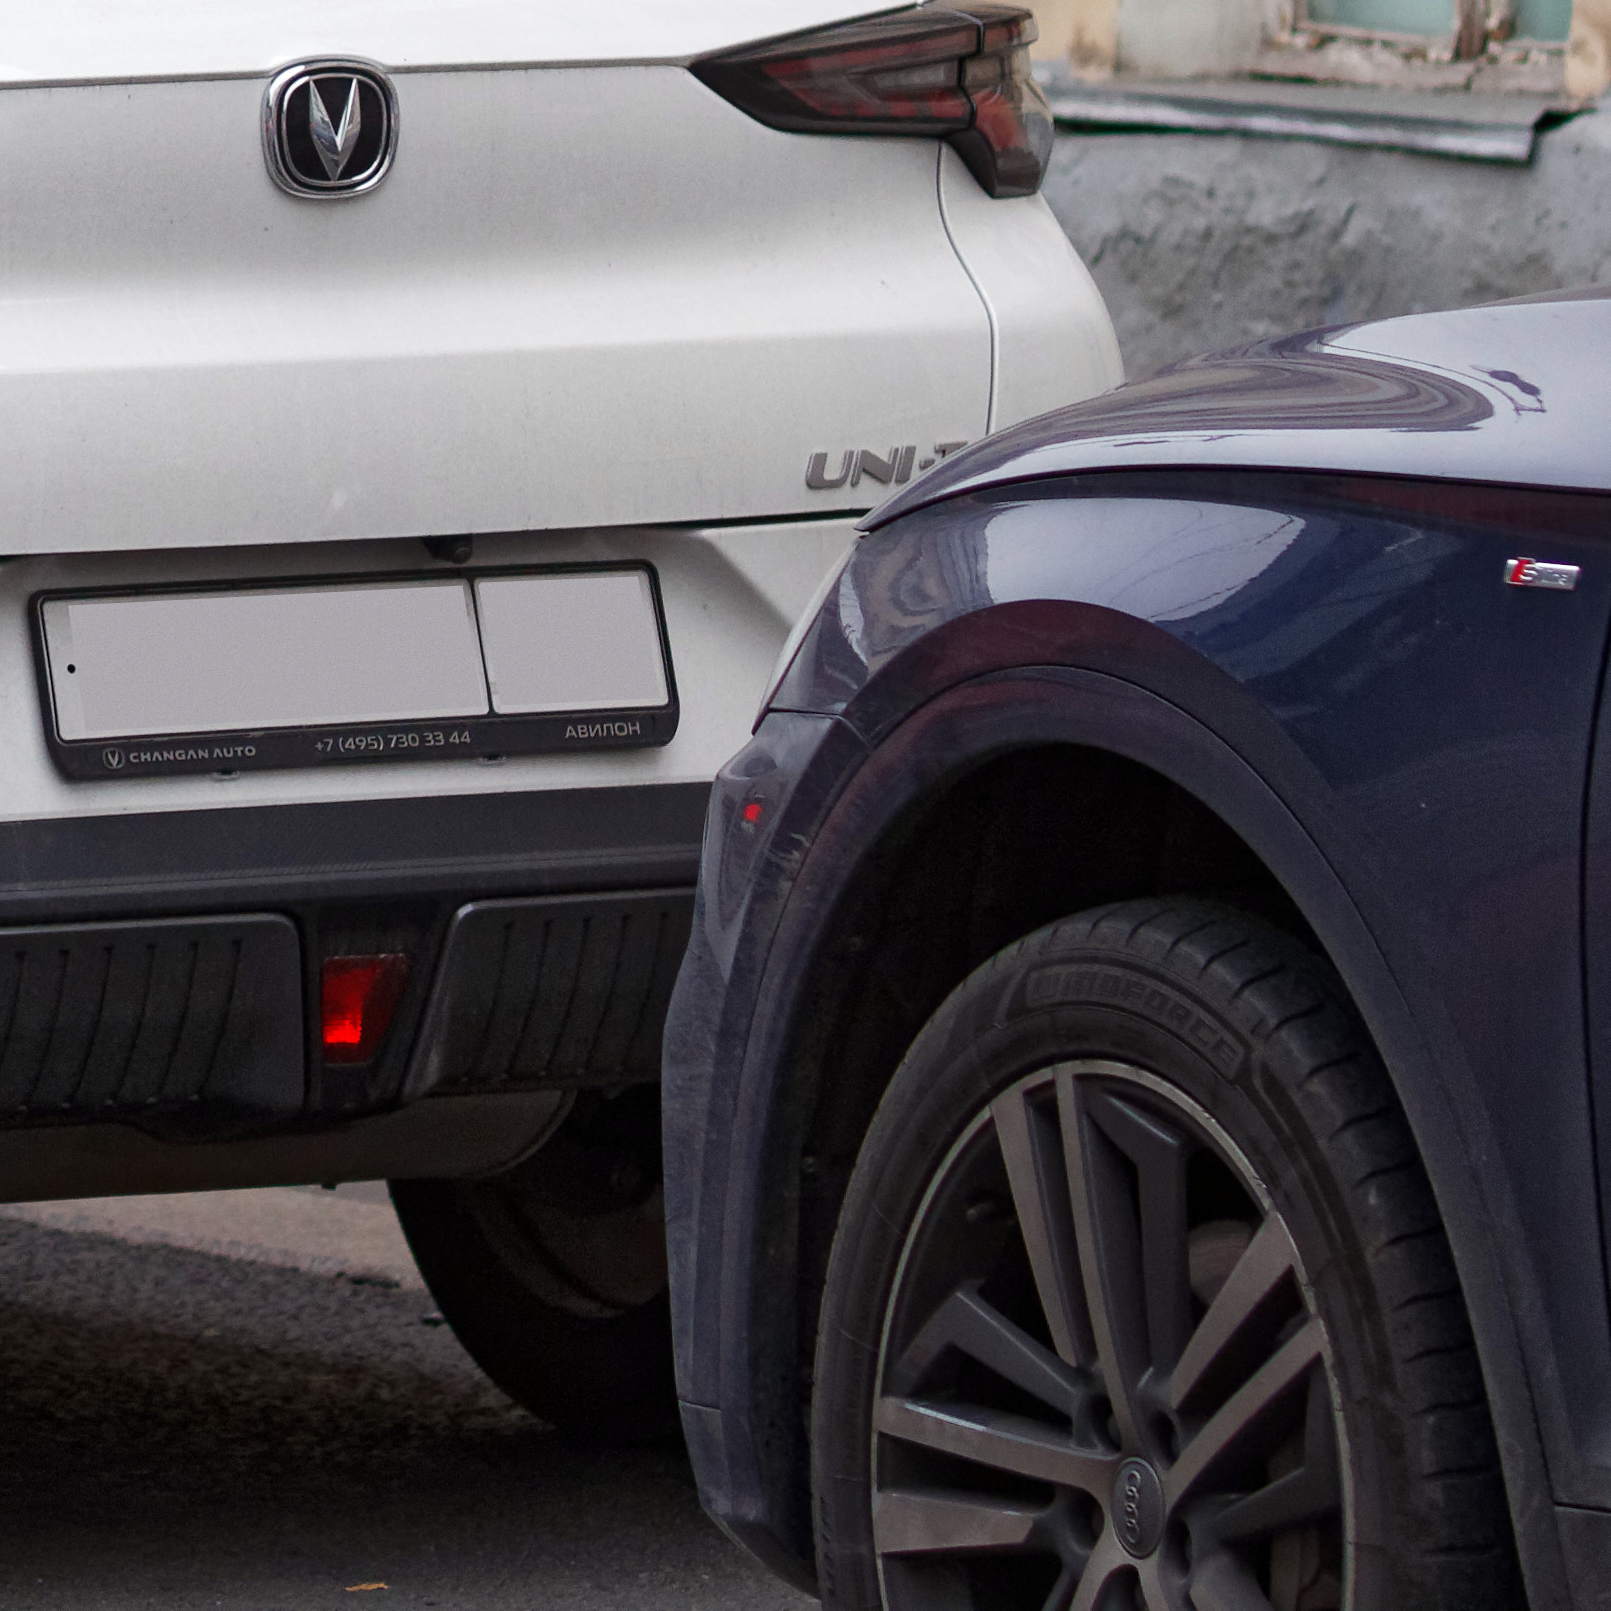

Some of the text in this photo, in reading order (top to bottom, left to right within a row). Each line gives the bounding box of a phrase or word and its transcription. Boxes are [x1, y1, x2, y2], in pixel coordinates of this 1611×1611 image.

[564, 721, 641, 740] АВИЛОН
[314, 730, 471, 752] +7 (495) 730 33 44
[129, 746, 256, 764] CHANGAN AUTO
